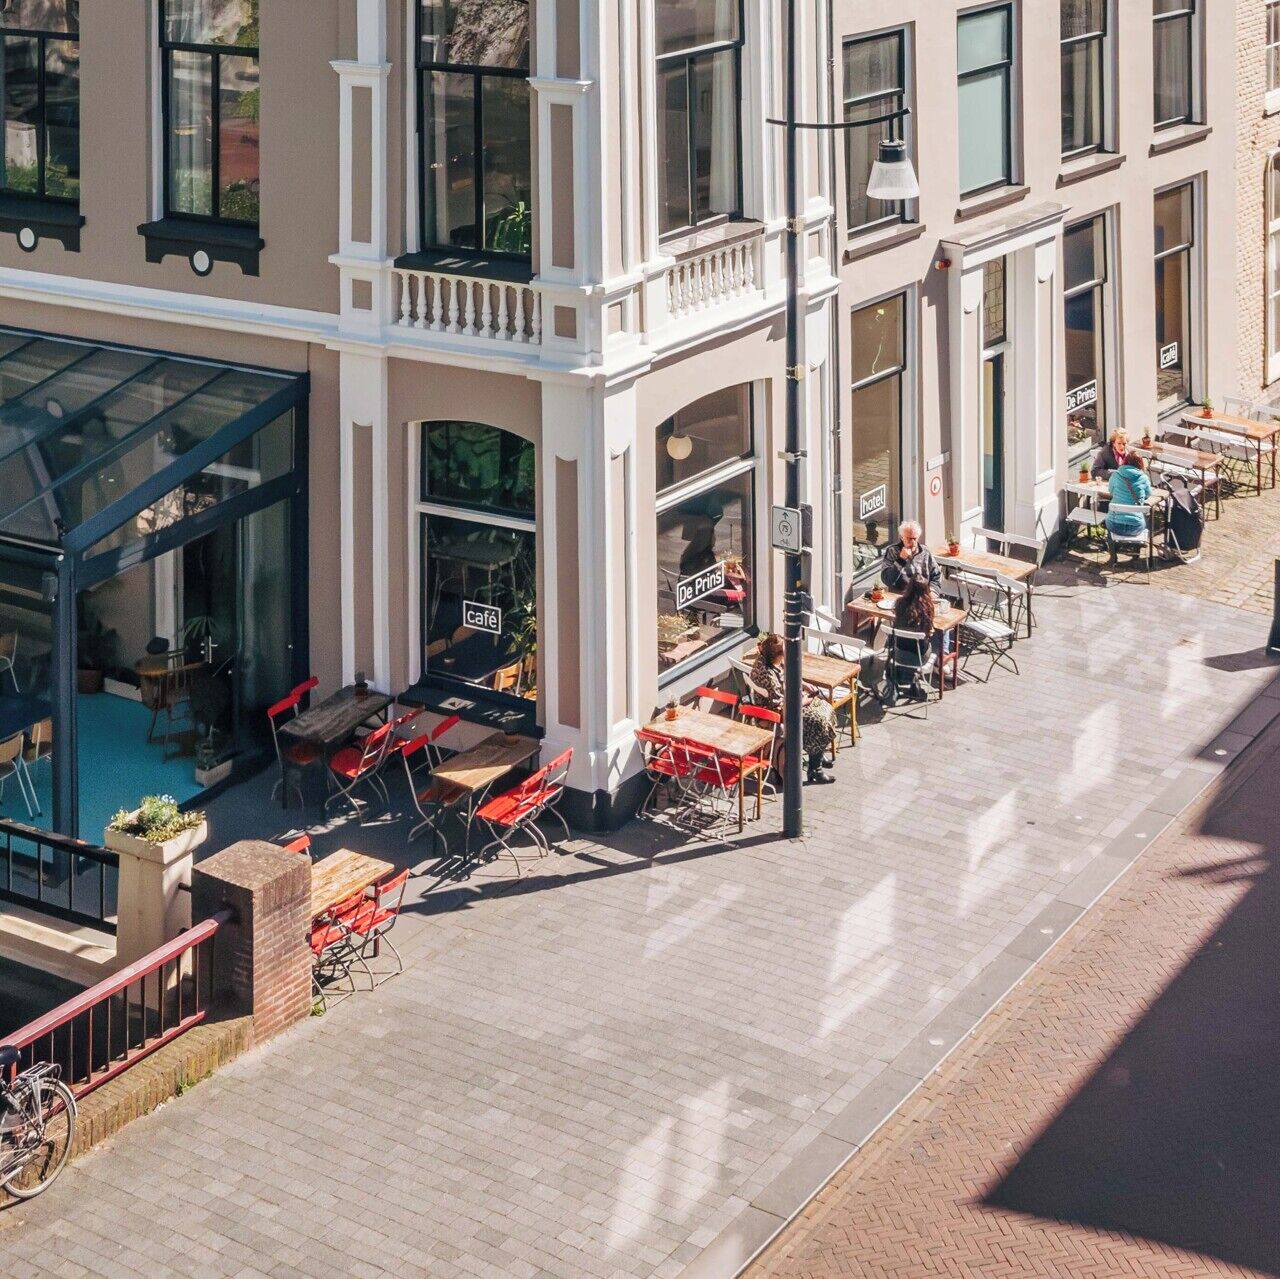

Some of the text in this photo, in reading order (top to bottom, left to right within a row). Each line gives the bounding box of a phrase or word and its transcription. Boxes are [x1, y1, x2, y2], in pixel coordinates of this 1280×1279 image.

[1066, 387, 1096, 410] De Prins
[862, 489, 884, 514] hotel
[679, 571, 722, 603] De Prins
[467, 610, 497, 628] café
